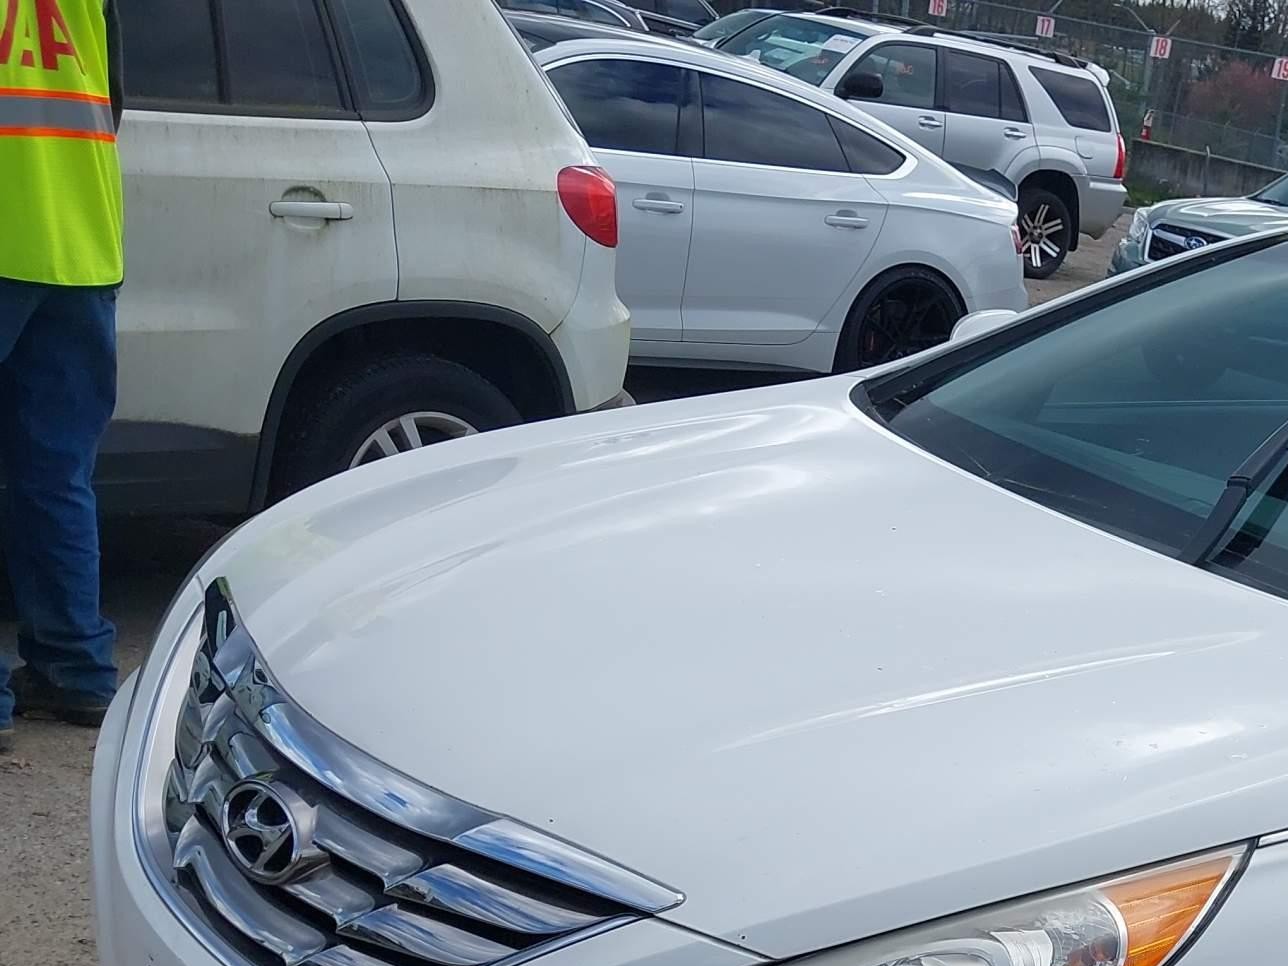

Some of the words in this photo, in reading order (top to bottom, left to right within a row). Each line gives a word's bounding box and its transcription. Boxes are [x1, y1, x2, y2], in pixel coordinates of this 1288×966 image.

[931, 0, 944, 15] 16
[1040, 18, 1051, 35] 17
[1154, 37, 1168, 57] 18
